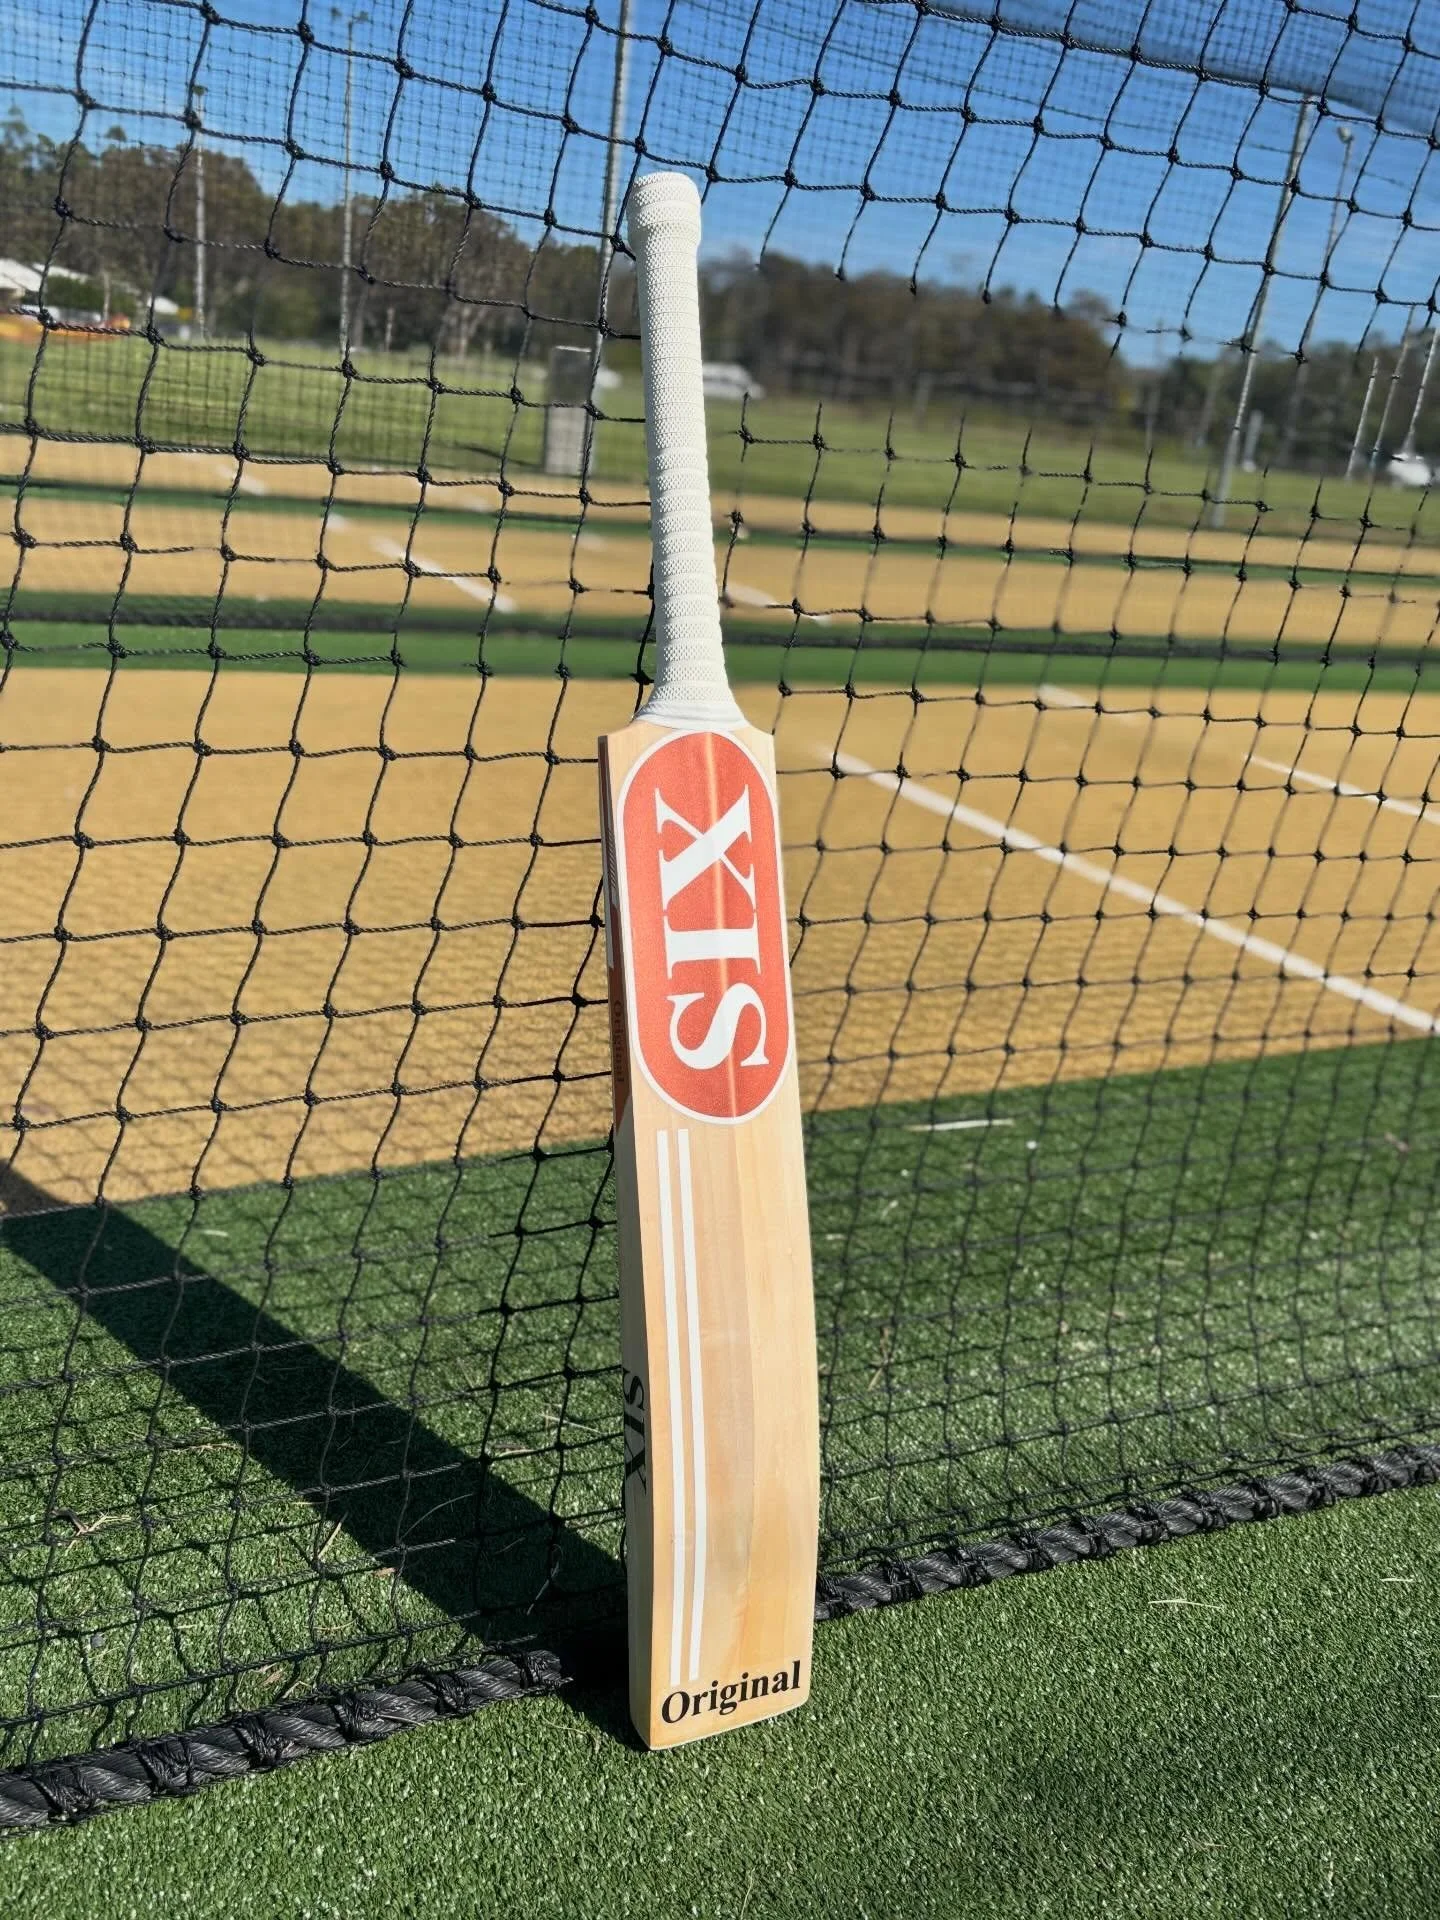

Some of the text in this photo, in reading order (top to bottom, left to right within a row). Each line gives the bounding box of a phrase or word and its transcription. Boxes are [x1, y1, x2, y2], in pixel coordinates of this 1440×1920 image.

[655, 784, 769, 1070] SIX
[622, 1368, 647, 1496] SIX
[661, 1660, 801, 1724] Original
